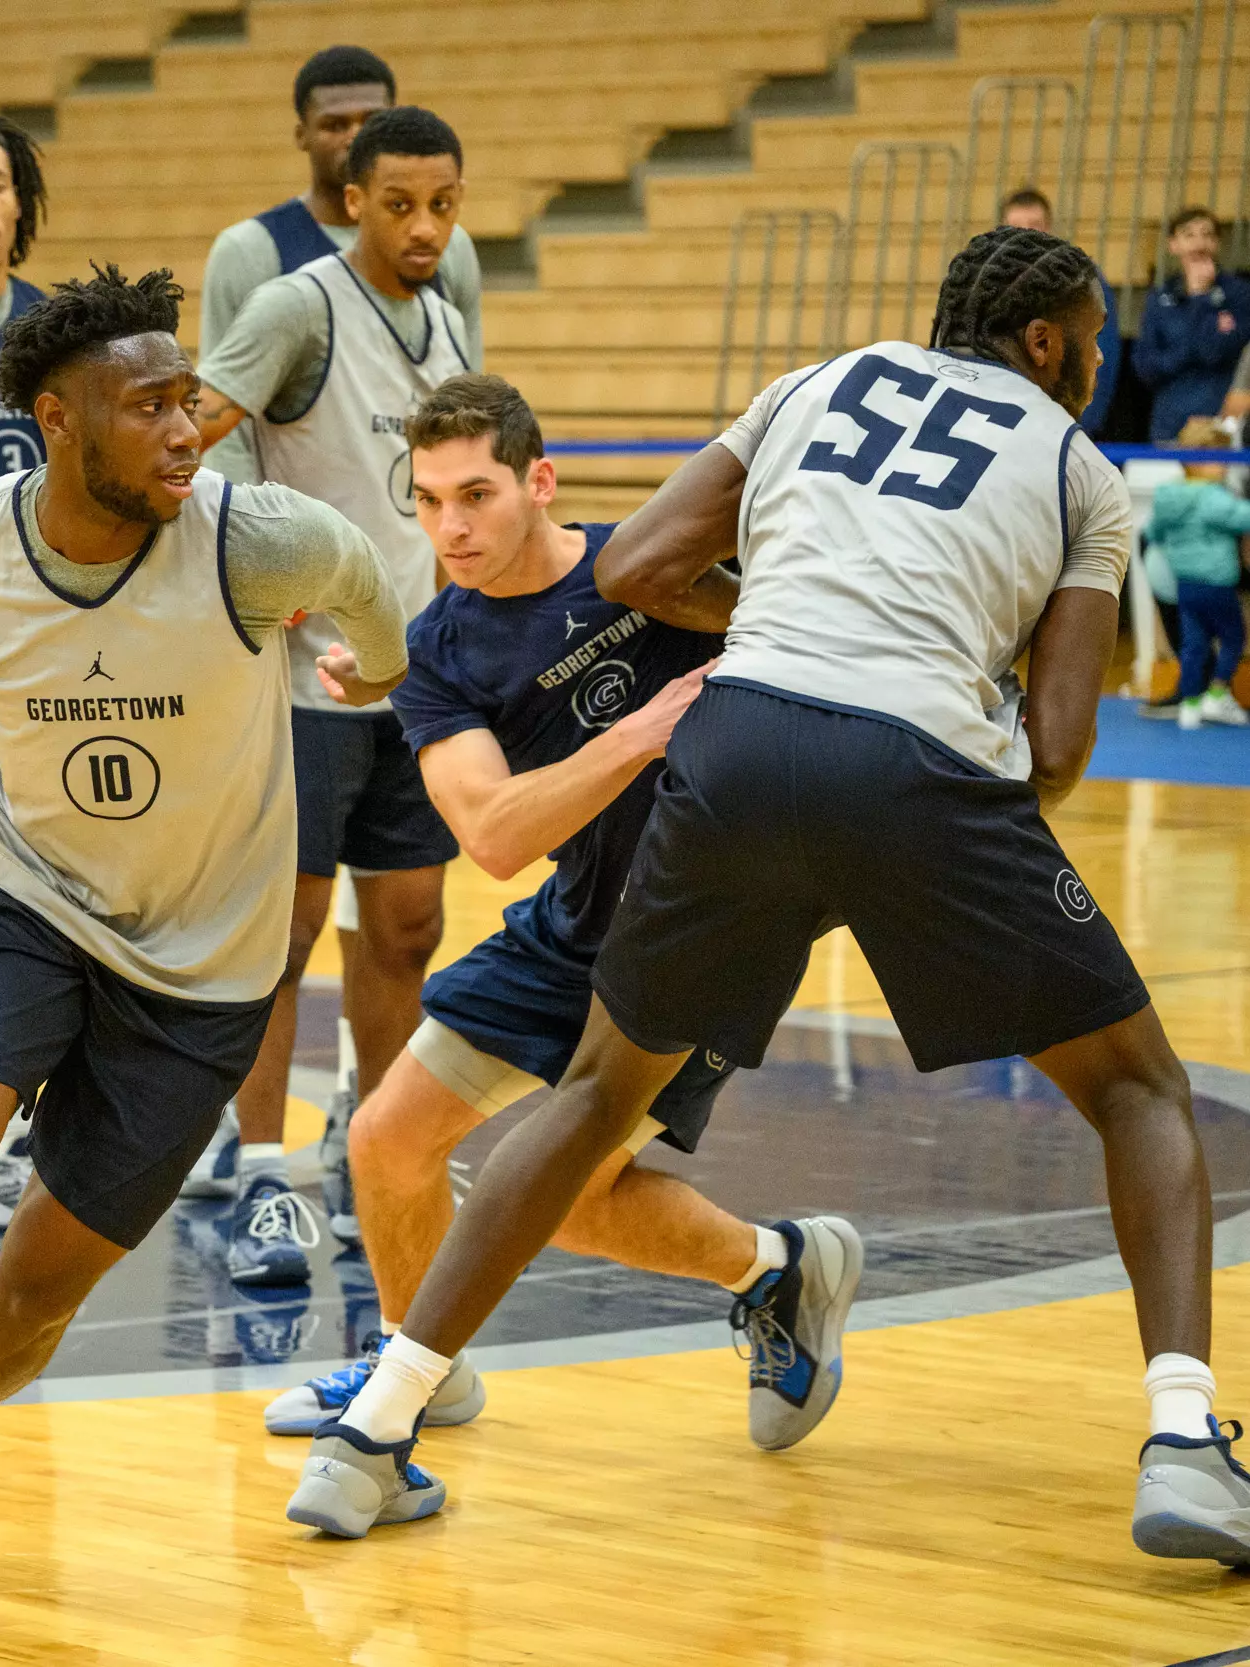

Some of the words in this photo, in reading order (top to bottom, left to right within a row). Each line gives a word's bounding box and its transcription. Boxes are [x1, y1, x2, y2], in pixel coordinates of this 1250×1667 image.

[798, 354, 1028, 511] 55
[536, 610, 648, 690] GEORGETOWN
[26, 694, 185, 722] GEORGETOWN
[88, 754, 133, 803] 10
[1054, 868, 1098, 923] G
